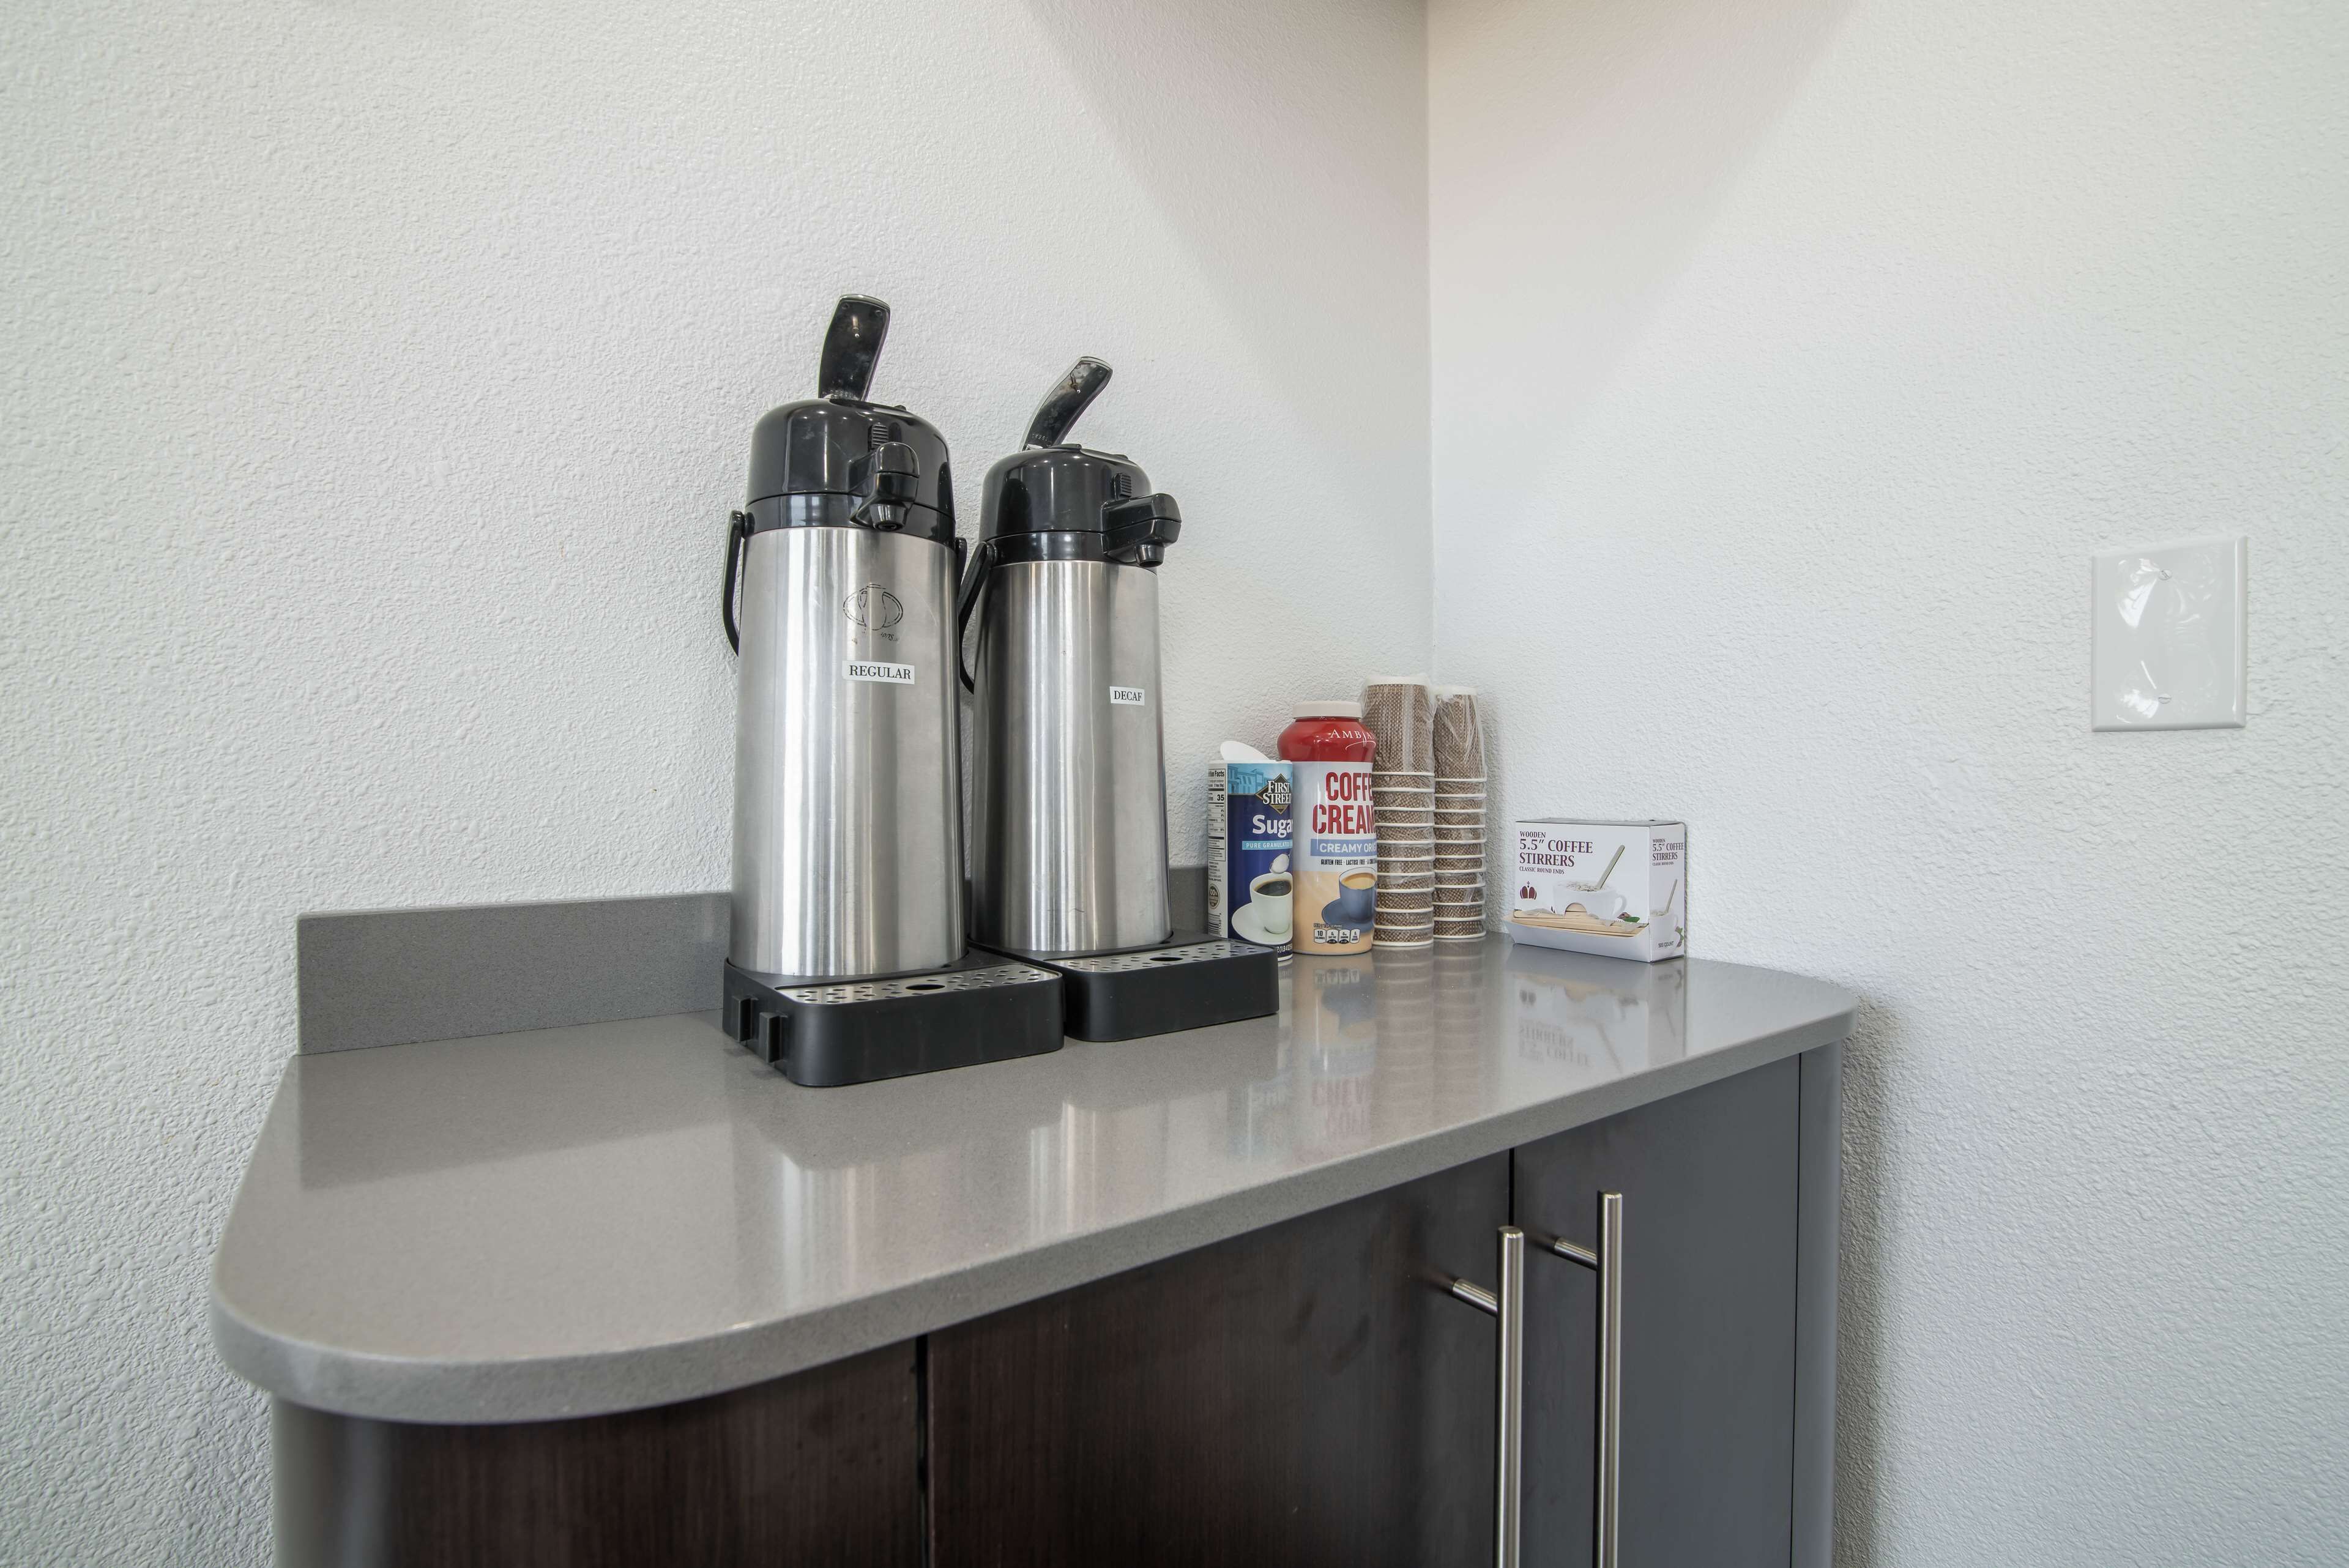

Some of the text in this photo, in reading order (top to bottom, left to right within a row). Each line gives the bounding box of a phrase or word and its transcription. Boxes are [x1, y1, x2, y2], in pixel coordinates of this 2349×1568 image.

[849, 665, 911, 680] REGULAR
[1114, 690, 1142, 701] DECAF
[1267, 780, 1290, 793] FIRST
[1262, 793, 1292, 804] STREET
[1319, 843, 1363, 853] CREAMY
[1547, 839, 1593, 853] COFFEE
[1666, 842, 1684, 851] COFFEE
[1519, 852, 1575, 868] STIRRERS
[1652, 852, 1678, 861] STIRRERS
